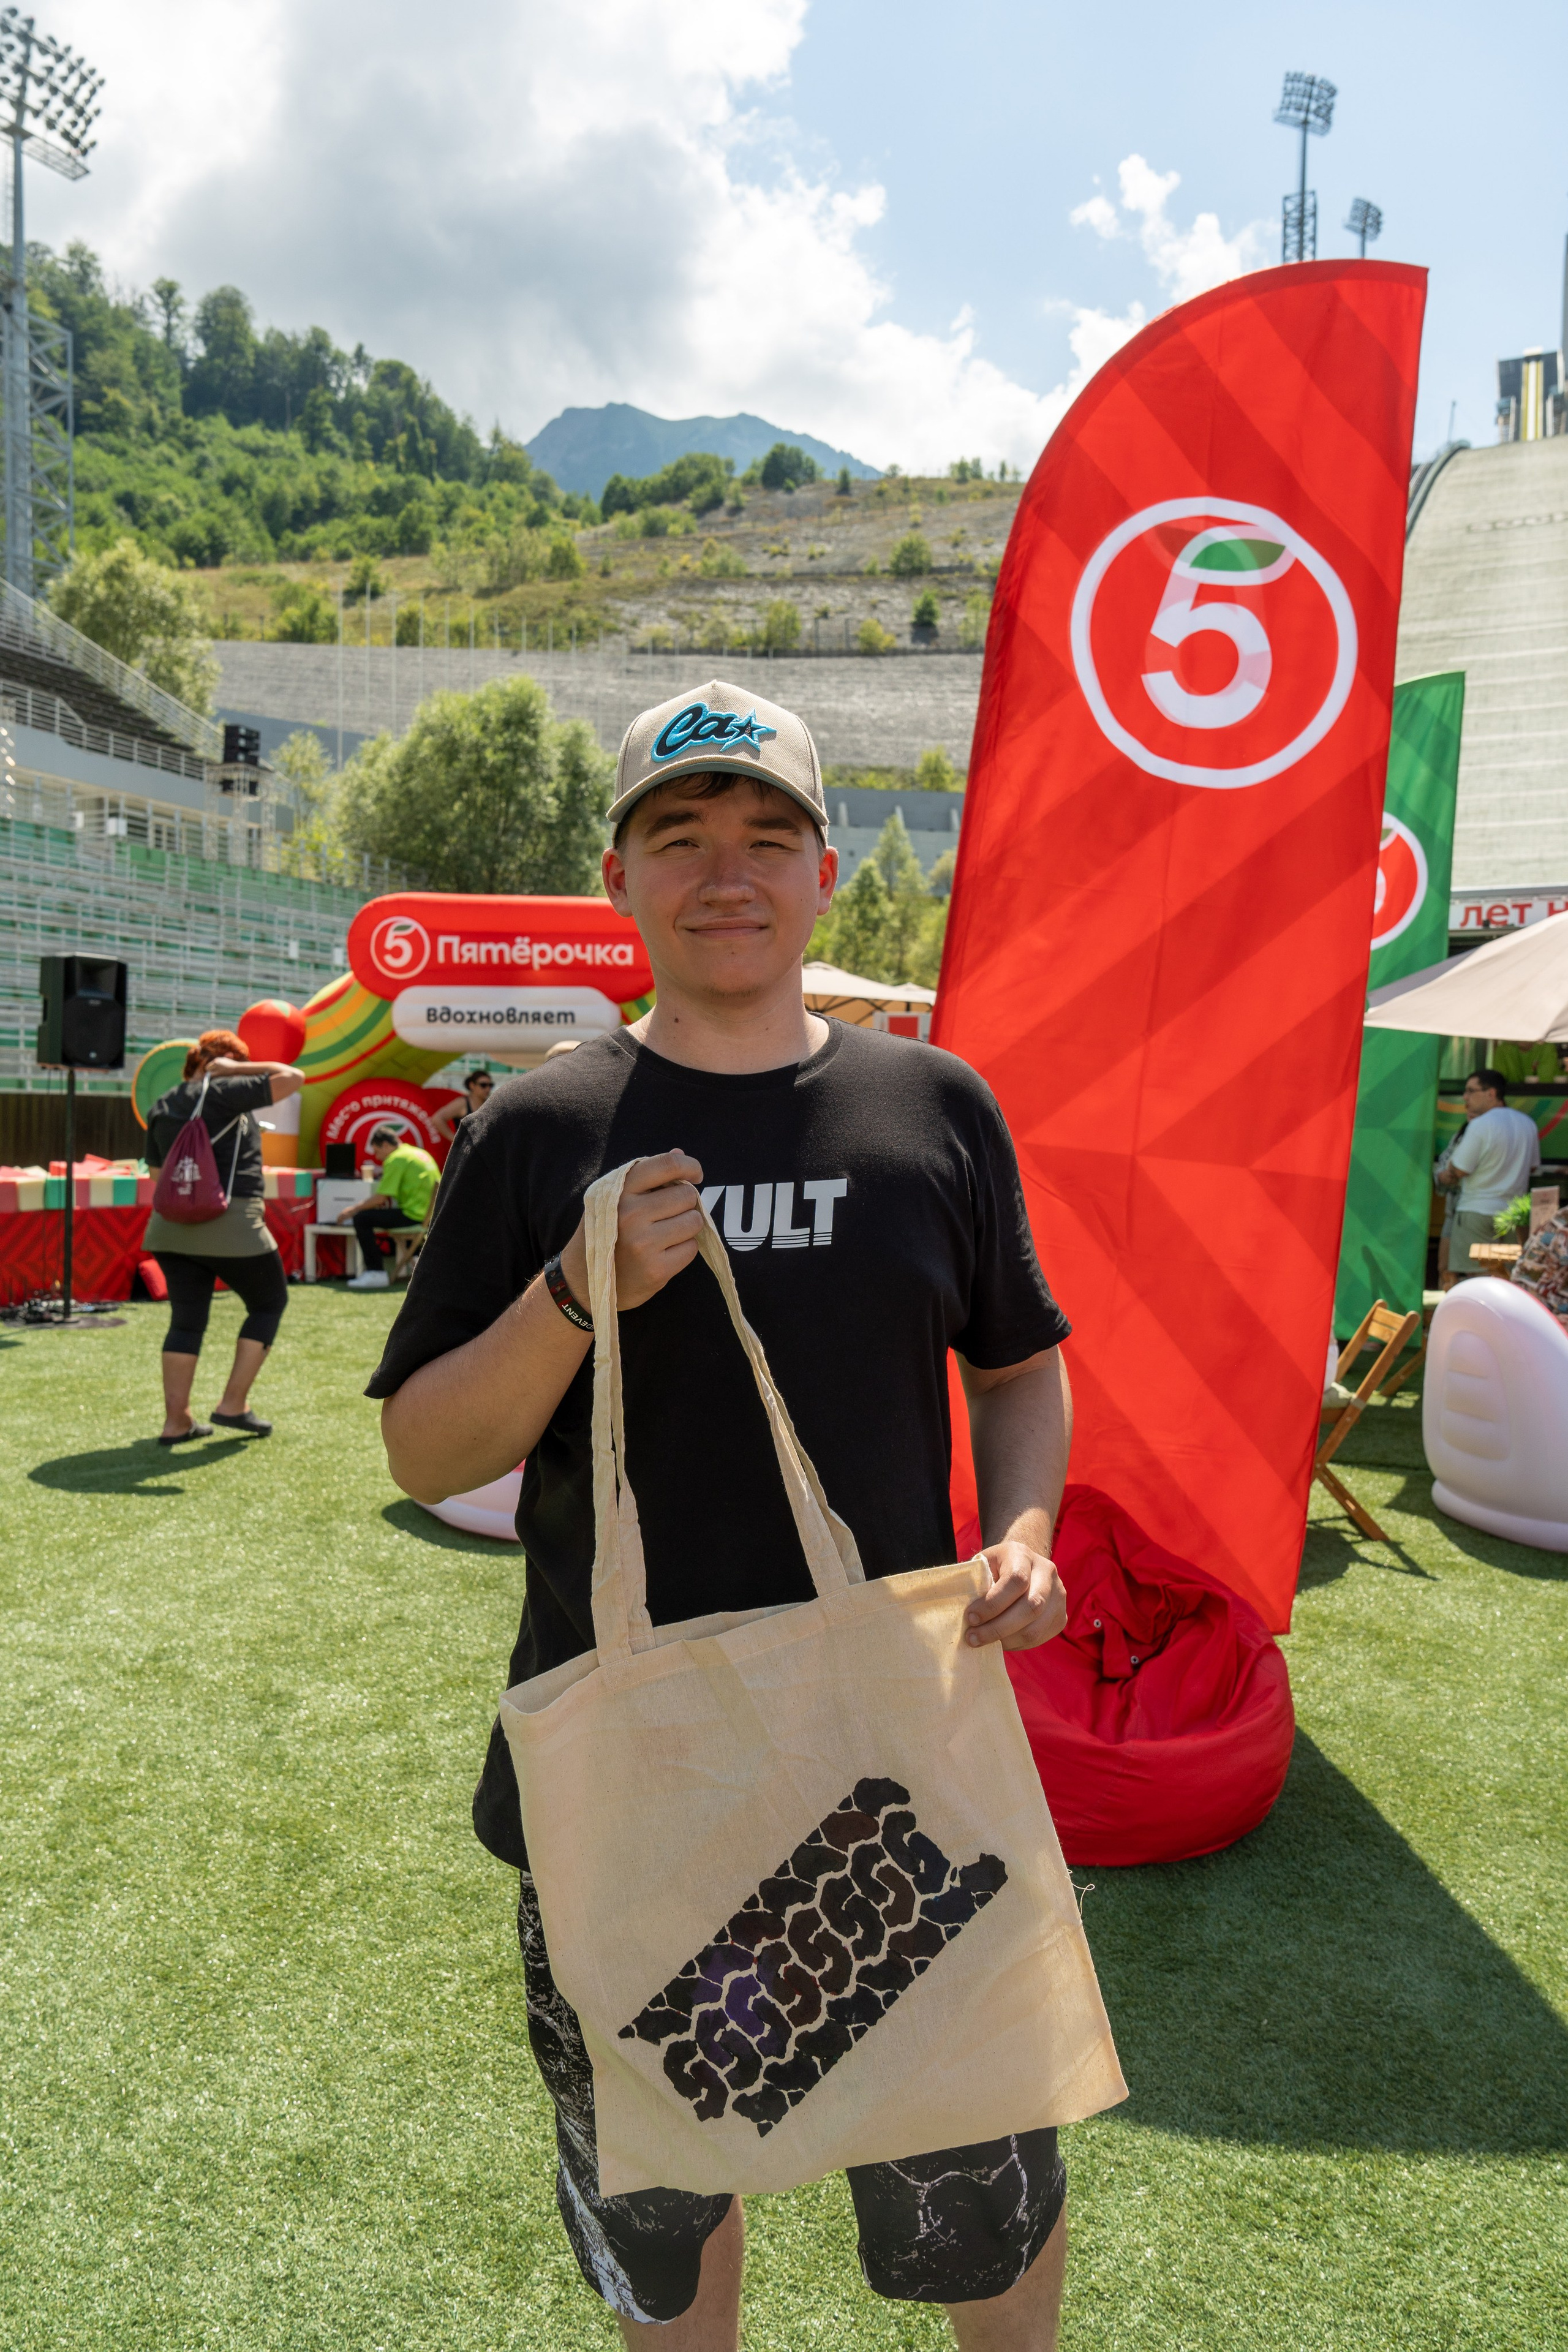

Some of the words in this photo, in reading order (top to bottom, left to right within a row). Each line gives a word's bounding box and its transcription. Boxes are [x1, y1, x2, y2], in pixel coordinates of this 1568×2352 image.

[1141, 524, 1297, 729] 5
[1460, 902, 1533, 928] лет
[437, 935, 634, 970] Пятёрочка
[426, 1006, 576, 1025] Вдохновляет
